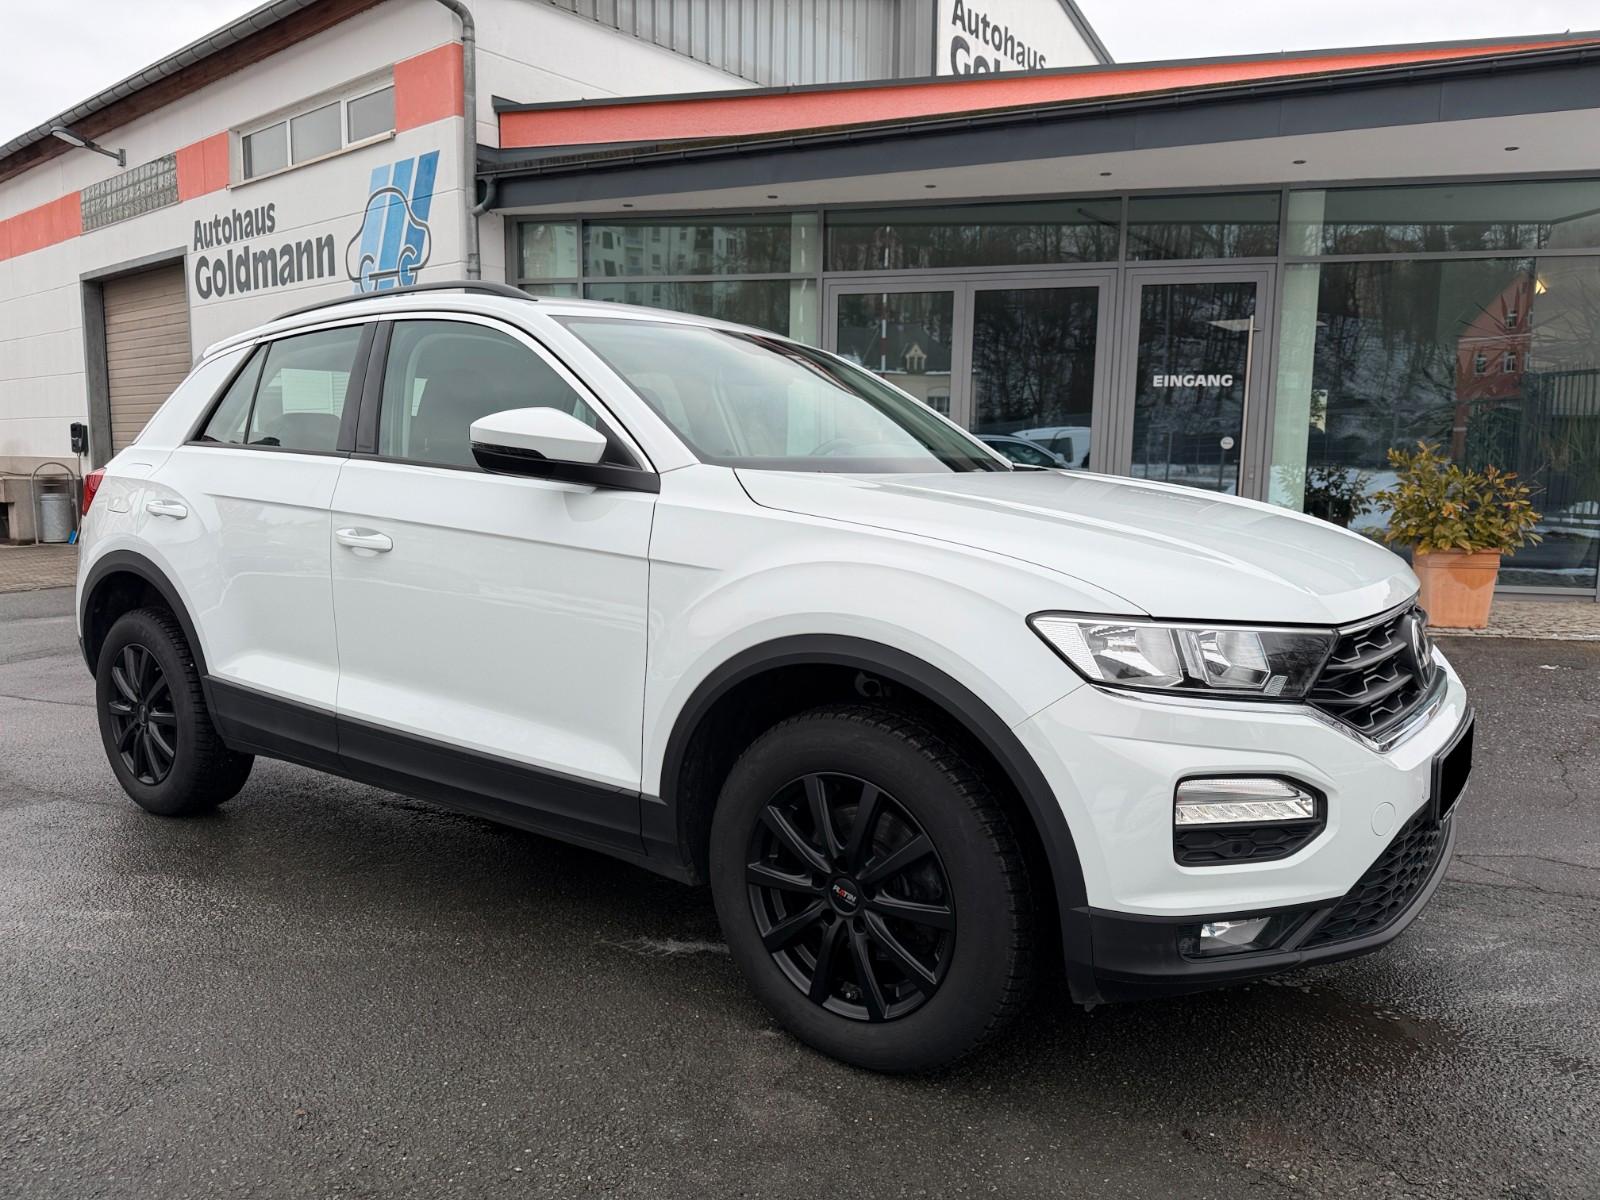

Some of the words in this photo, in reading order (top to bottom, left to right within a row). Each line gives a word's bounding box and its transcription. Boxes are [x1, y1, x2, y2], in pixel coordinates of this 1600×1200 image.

[951, 0, 1046, 70] Autohaus
[193, 202, 275, 251] Autohaus
[195, 233, 336, 300] Goldmann
[1152, 374, 1233, 388] EINGANG
